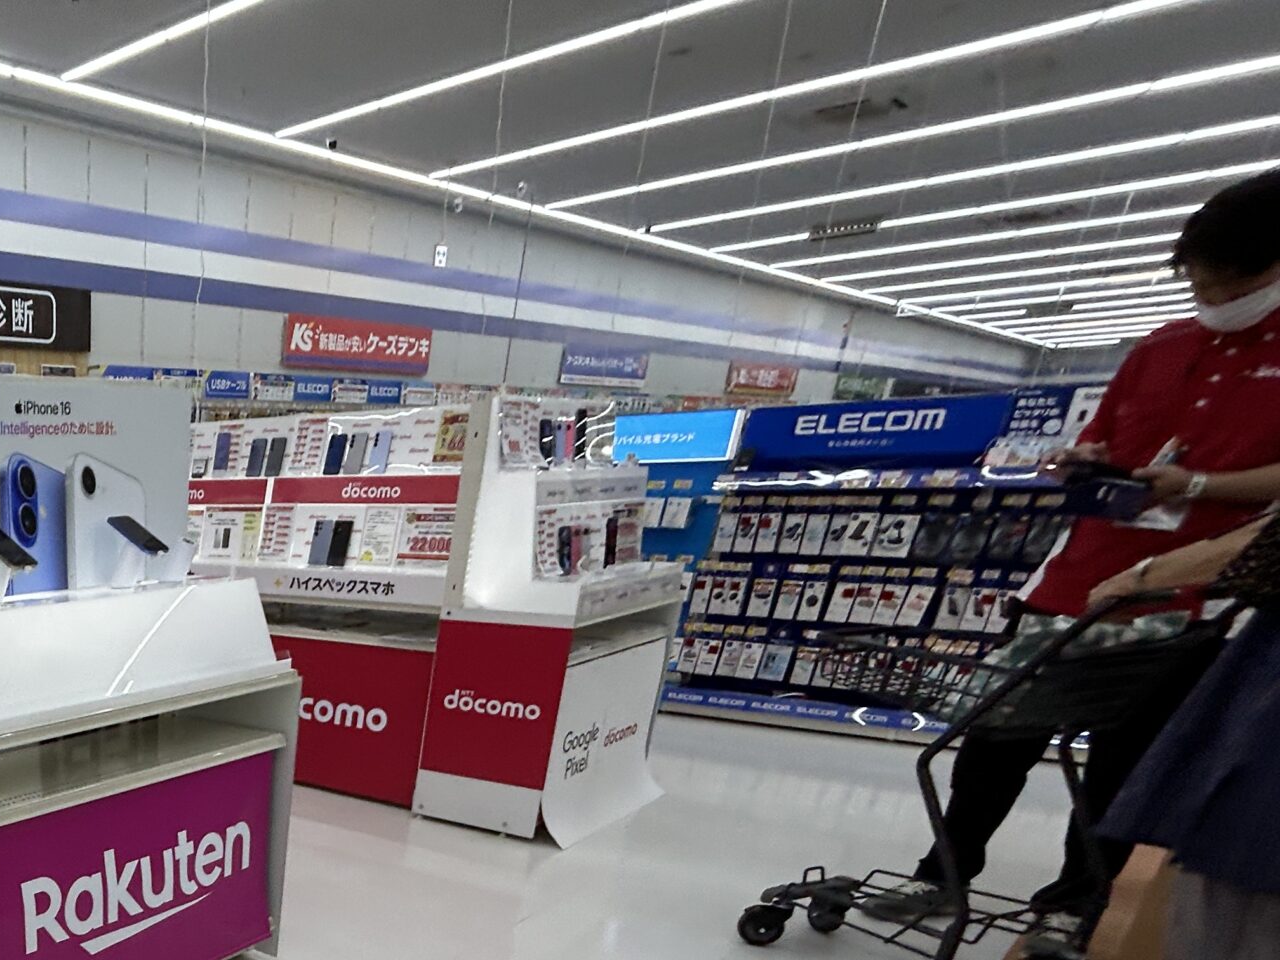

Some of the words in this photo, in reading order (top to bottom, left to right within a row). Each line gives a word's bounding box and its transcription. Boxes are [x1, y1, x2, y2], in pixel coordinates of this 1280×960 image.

[366, 332, 430, 358] ケーズデンキ
[296, 382, 330, 395] ELECOM
[23, 400, 59, 415] iPhone
[60, 401, 72, 416] 16
[793, 408, 948, 436] ELECOM
[341, 482, 401, 498] docomo
[289, 577, 396, 597] ハイスペックスマホ
[443, 689, 541, 721] docomo
[562, 721, 600, 754] Google
[604, 722, 638, 748] docomo
[563, 751, 589, 780] Pixel
[20, 820, 251, 955] Rakuten
